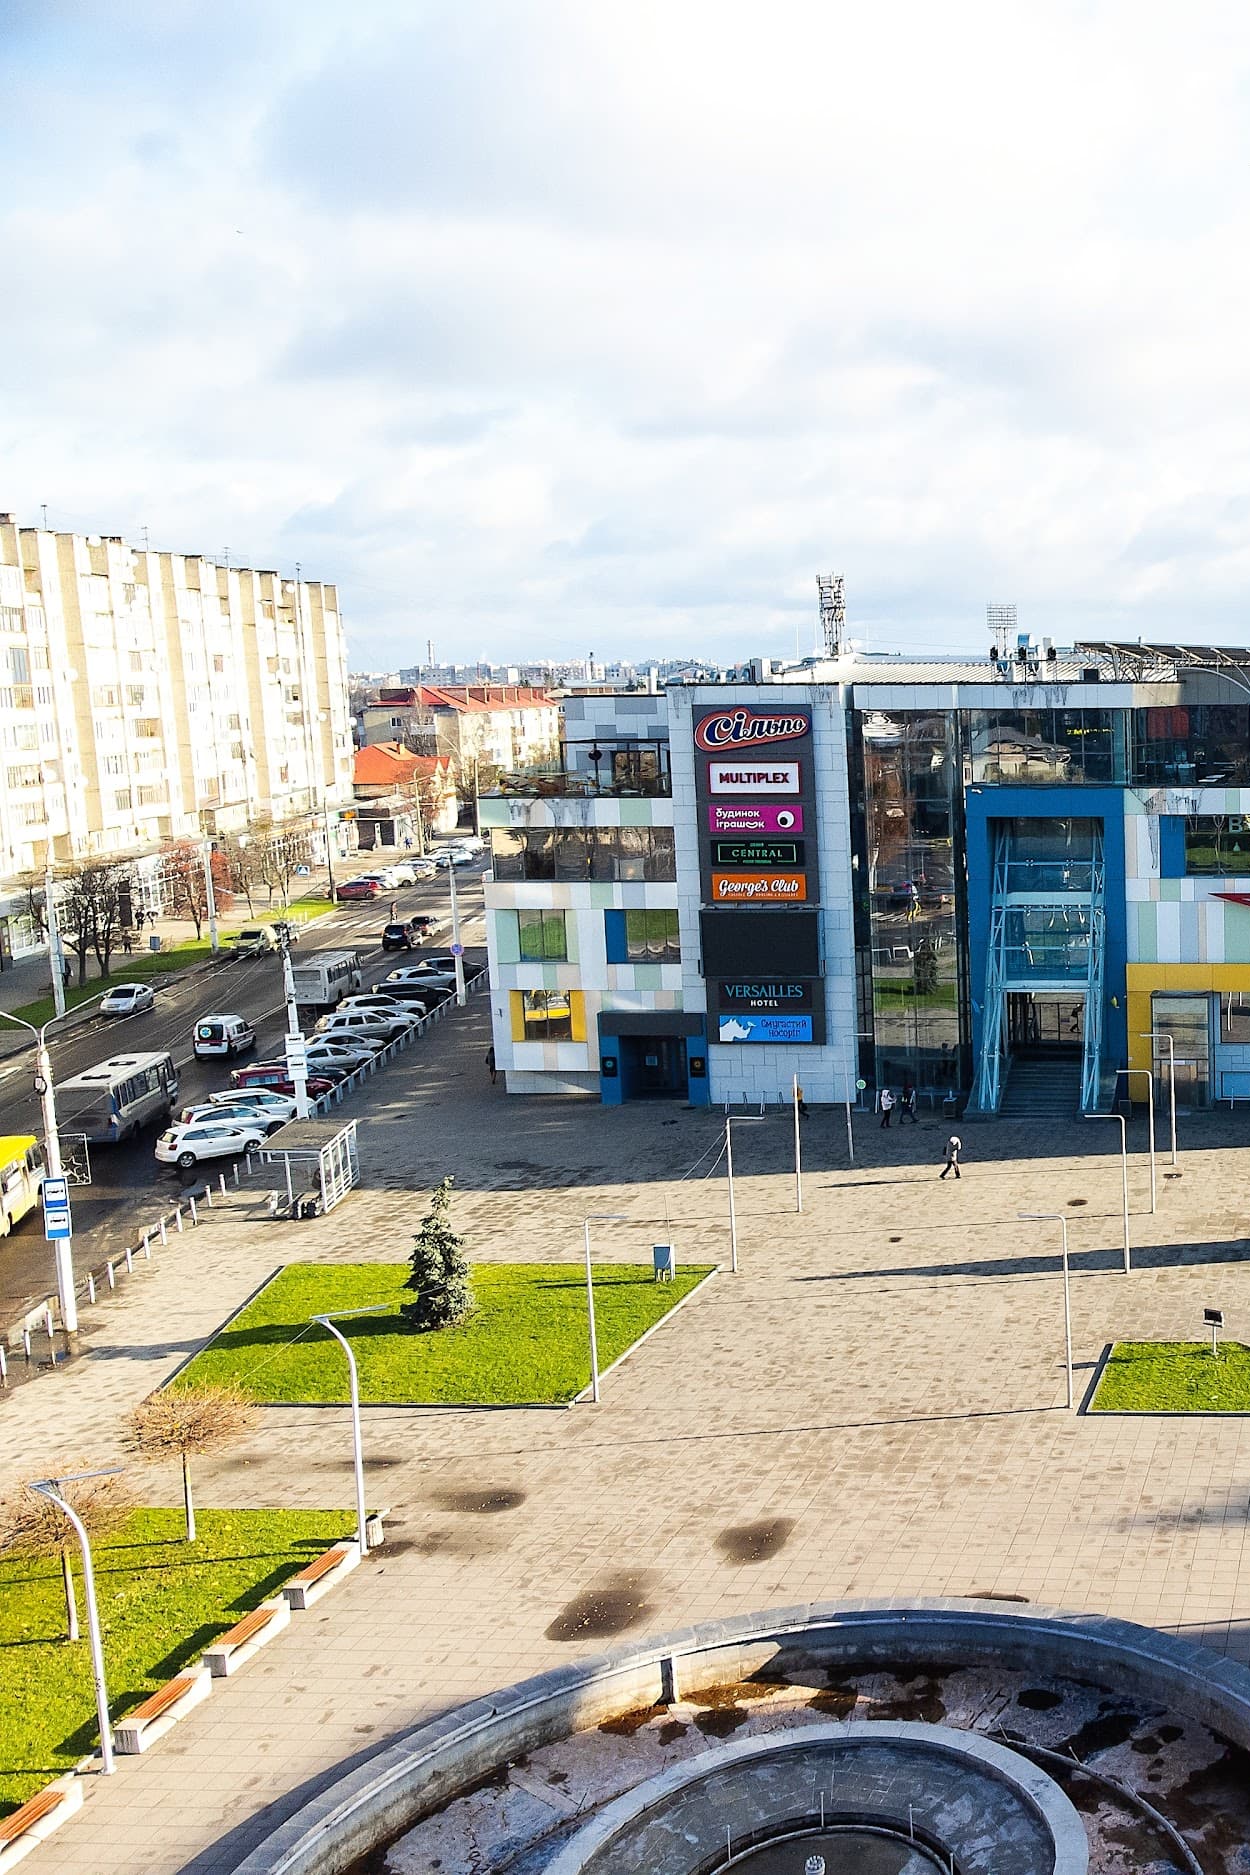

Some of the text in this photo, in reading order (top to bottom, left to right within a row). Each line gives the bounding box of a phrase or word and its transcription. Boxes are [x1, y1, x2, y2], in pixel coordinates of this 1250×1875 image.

[704, 712, 806, 745] Сільпо
[719, 772, 790, 784] MULTIPLEX
[716, 808, 760, 819] будинок
[731, 849, 784, 858] CENTRAL
[718, 879, 799, 897] George's Club
[724, 984, 804, 998] VERSAILLES
[750, 999, 779, 1007] HOTEL
